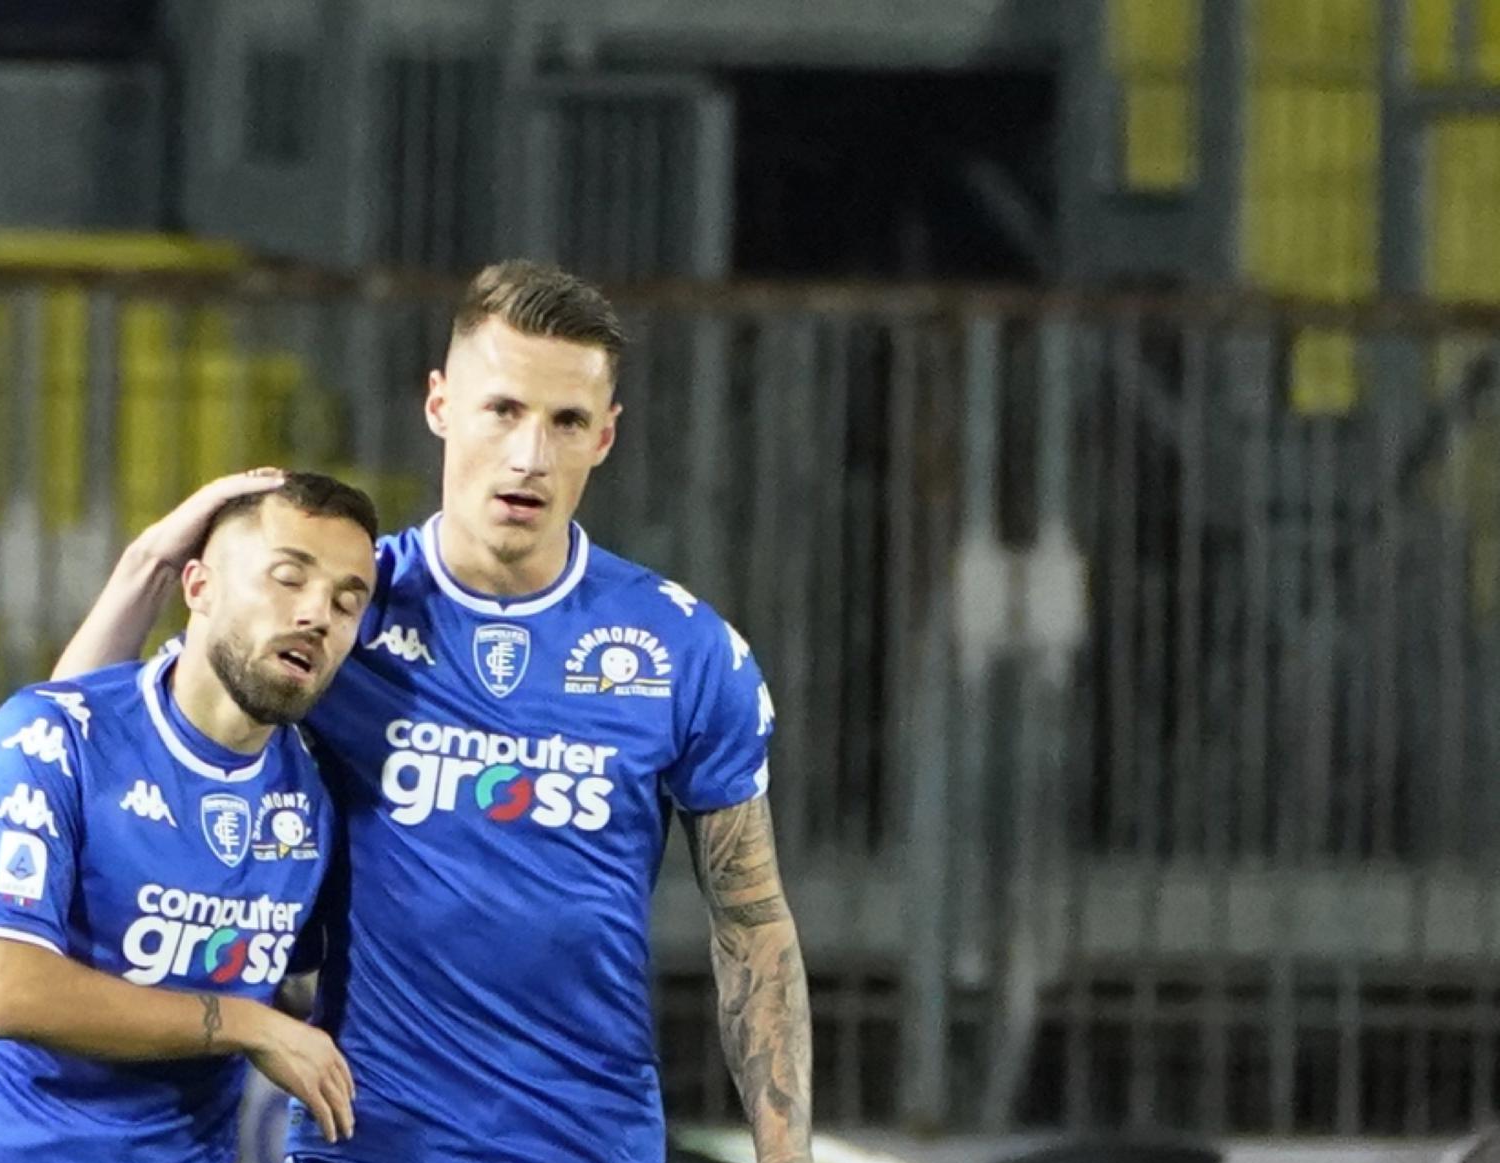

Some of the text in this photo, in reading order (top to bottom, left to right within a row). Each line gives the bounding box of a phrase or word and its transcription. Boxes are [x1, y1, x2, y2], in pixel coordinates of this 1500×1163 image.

[564, 626, 671, 675] SAMMONTANA
[385, 719, 618, 776] computer
[381, 750, 614, 831] gross
[137, 883, 302, 931] computer
[122, 916, 295, 986] gross
